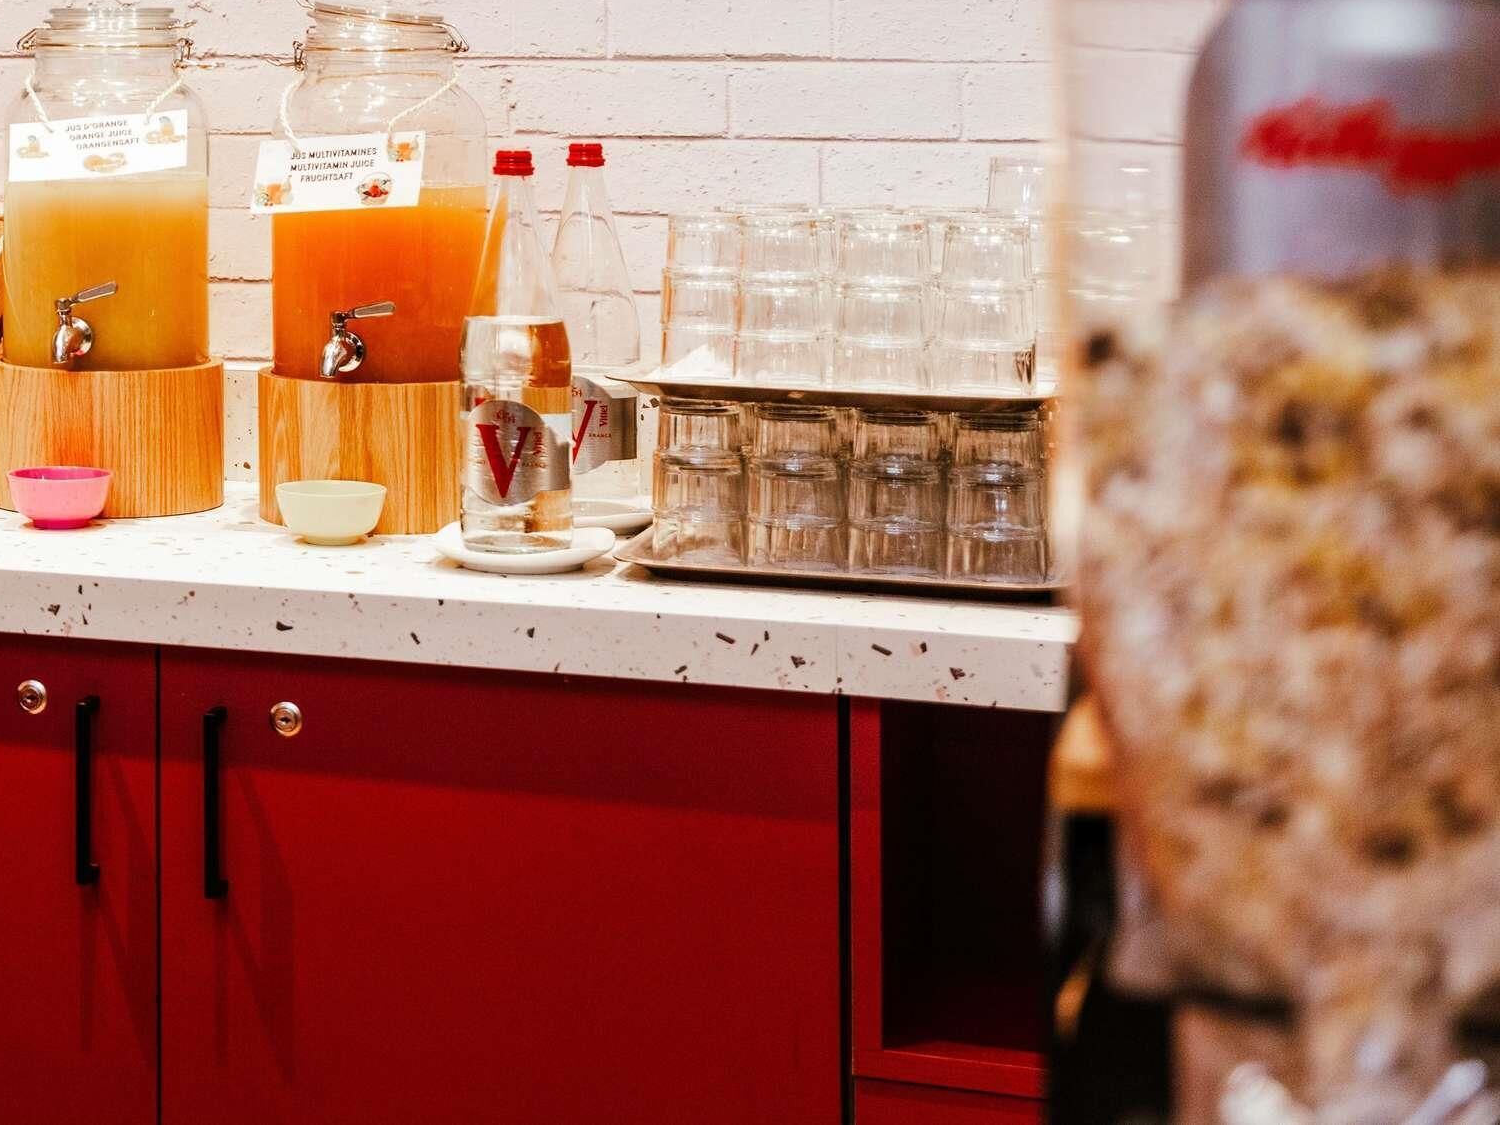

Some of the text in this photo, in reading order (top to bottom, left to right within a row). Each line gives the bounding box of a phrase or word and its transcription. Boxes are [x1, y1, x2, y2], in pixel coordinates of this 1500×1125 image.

[66, 120, 129, 132] JUS D'ORANGE
[69, 129, 133, 142] ORANGE JUICE
[76, 138, 140, 151] ORANGENSAFT
[308, 147, 377, 159] MULTIVITAMINES
[290, 159, 375, 172] MULTIVITAMIN JUICE
[300, 172, 353, 183] FRUCHTSAFT
[475, 423, 532, 498] V
